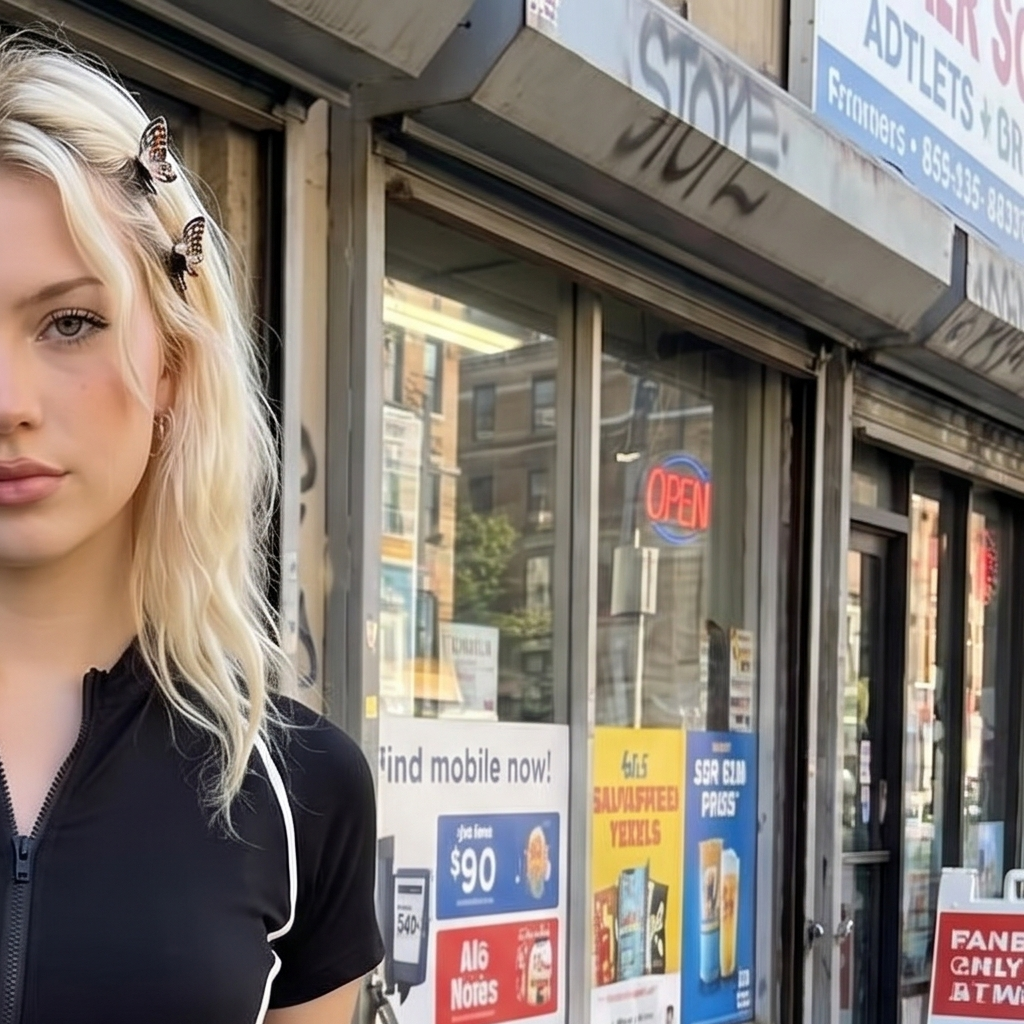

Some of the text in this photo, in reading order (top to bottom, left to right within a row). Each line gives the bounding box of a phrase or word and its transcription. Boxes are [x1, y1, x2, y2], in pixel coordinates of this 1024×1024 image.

[863, 0, 974, 131] ADTLETS
[647, 466, 711, 530] OPEN
[430, 747, 501, 784] mobile
[507, 749, 552, 784] now!
[449, 845, 497, 894] $90
